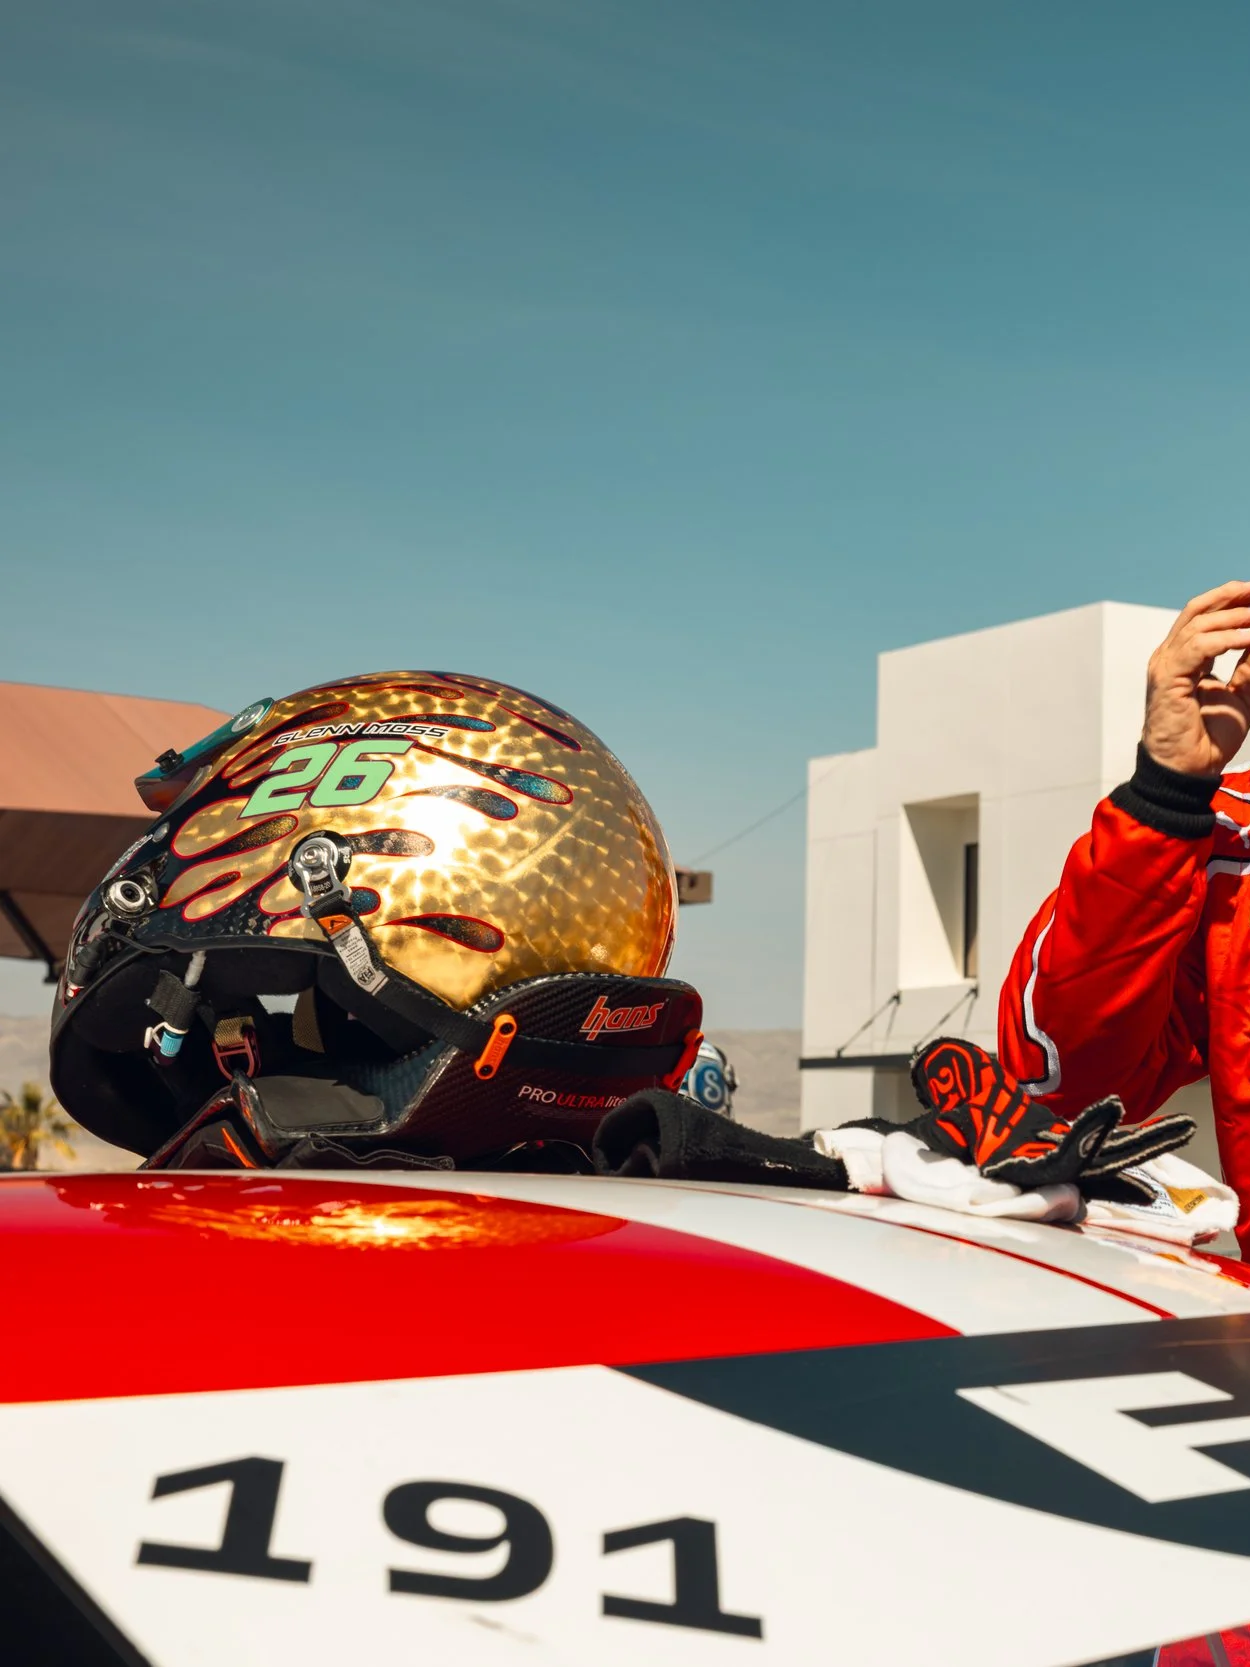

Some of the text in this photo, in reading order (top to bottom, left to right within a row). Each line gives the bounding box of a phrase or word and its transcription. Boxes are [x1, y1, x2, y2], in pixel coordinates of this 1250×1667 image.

[272, 722, 449, 746] GLENN MOSS
[237, 739, 418, 820] 26
[579, 995, 665, 1041] hans
[135, 1455, 765, 1642] 191
